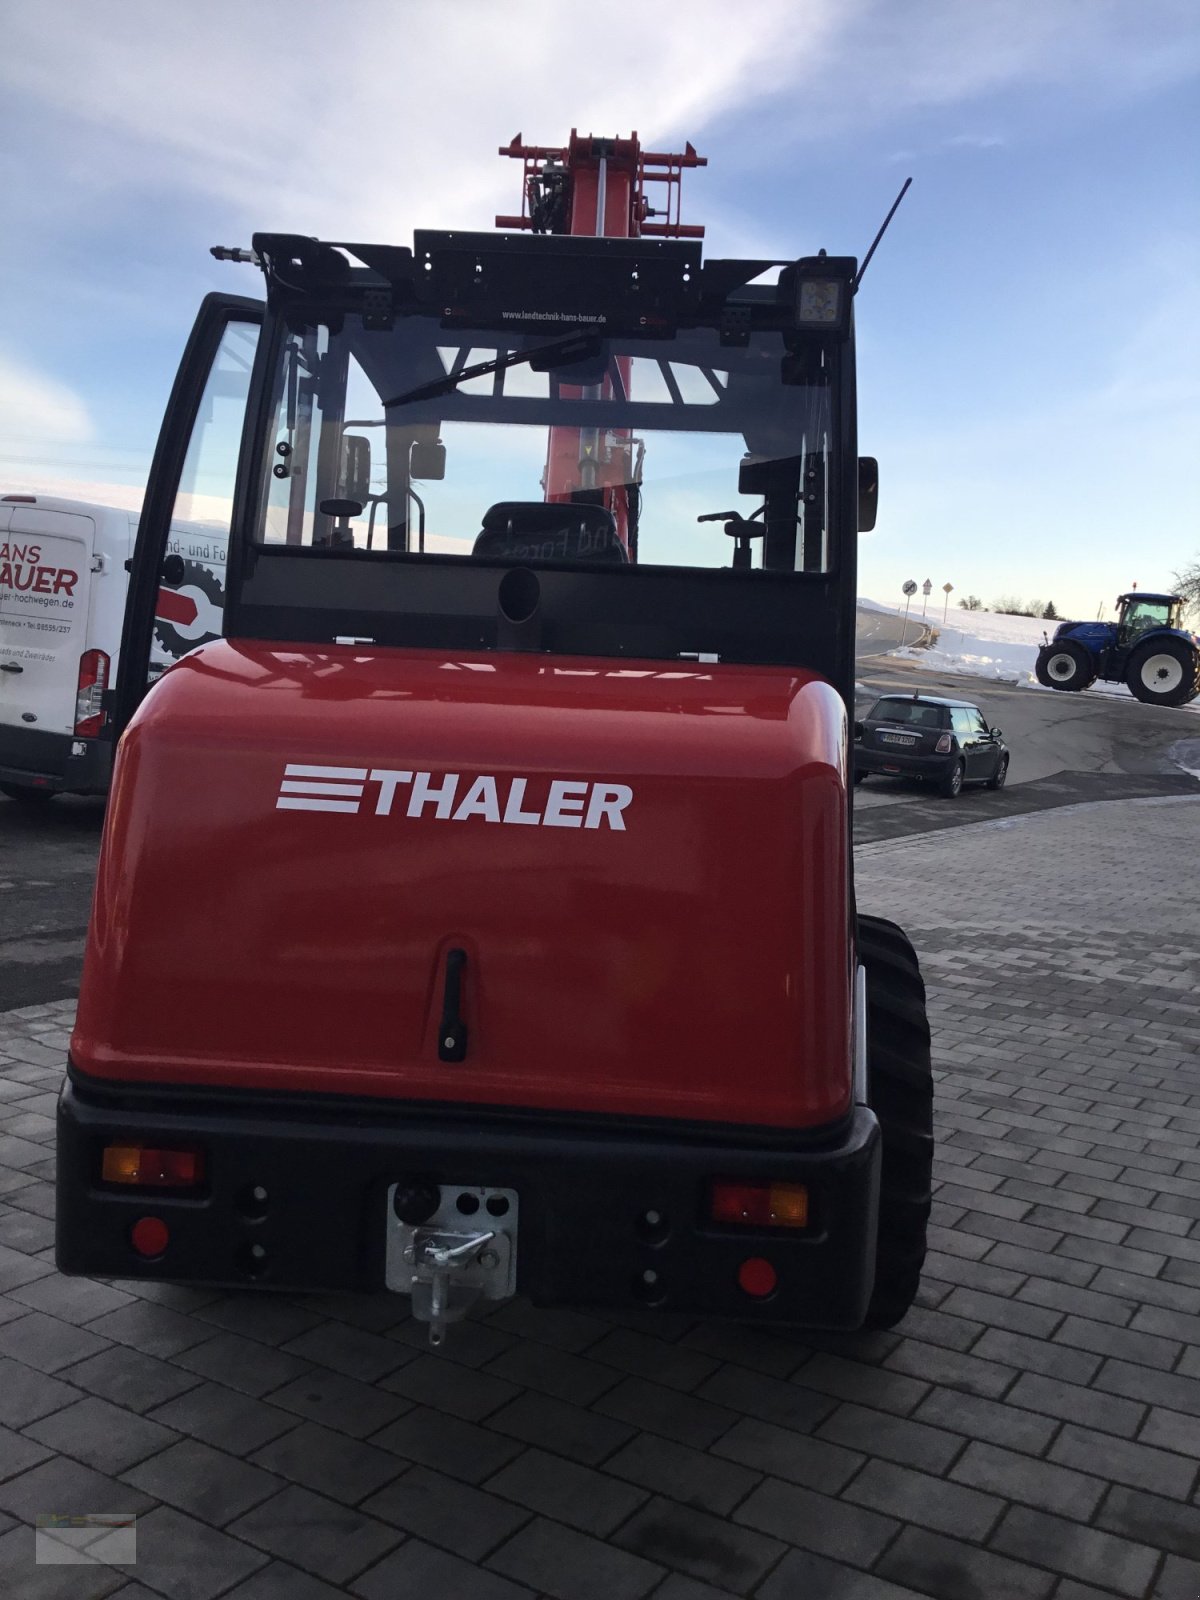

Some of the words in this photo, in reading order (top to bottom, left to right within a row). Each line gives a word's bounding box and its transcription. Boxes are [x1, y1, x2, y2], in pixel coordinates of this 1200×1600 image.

[502, 310, 607, 323] www.landtechnik-hans-bauer.de
[0, 543, 42, 564] ANS
[188, 544, 210, 558] und
[213, 546, 226, 561] Fo
[0, 563, 79, 597] AUER
[368, 768, 634, 831] THALER
